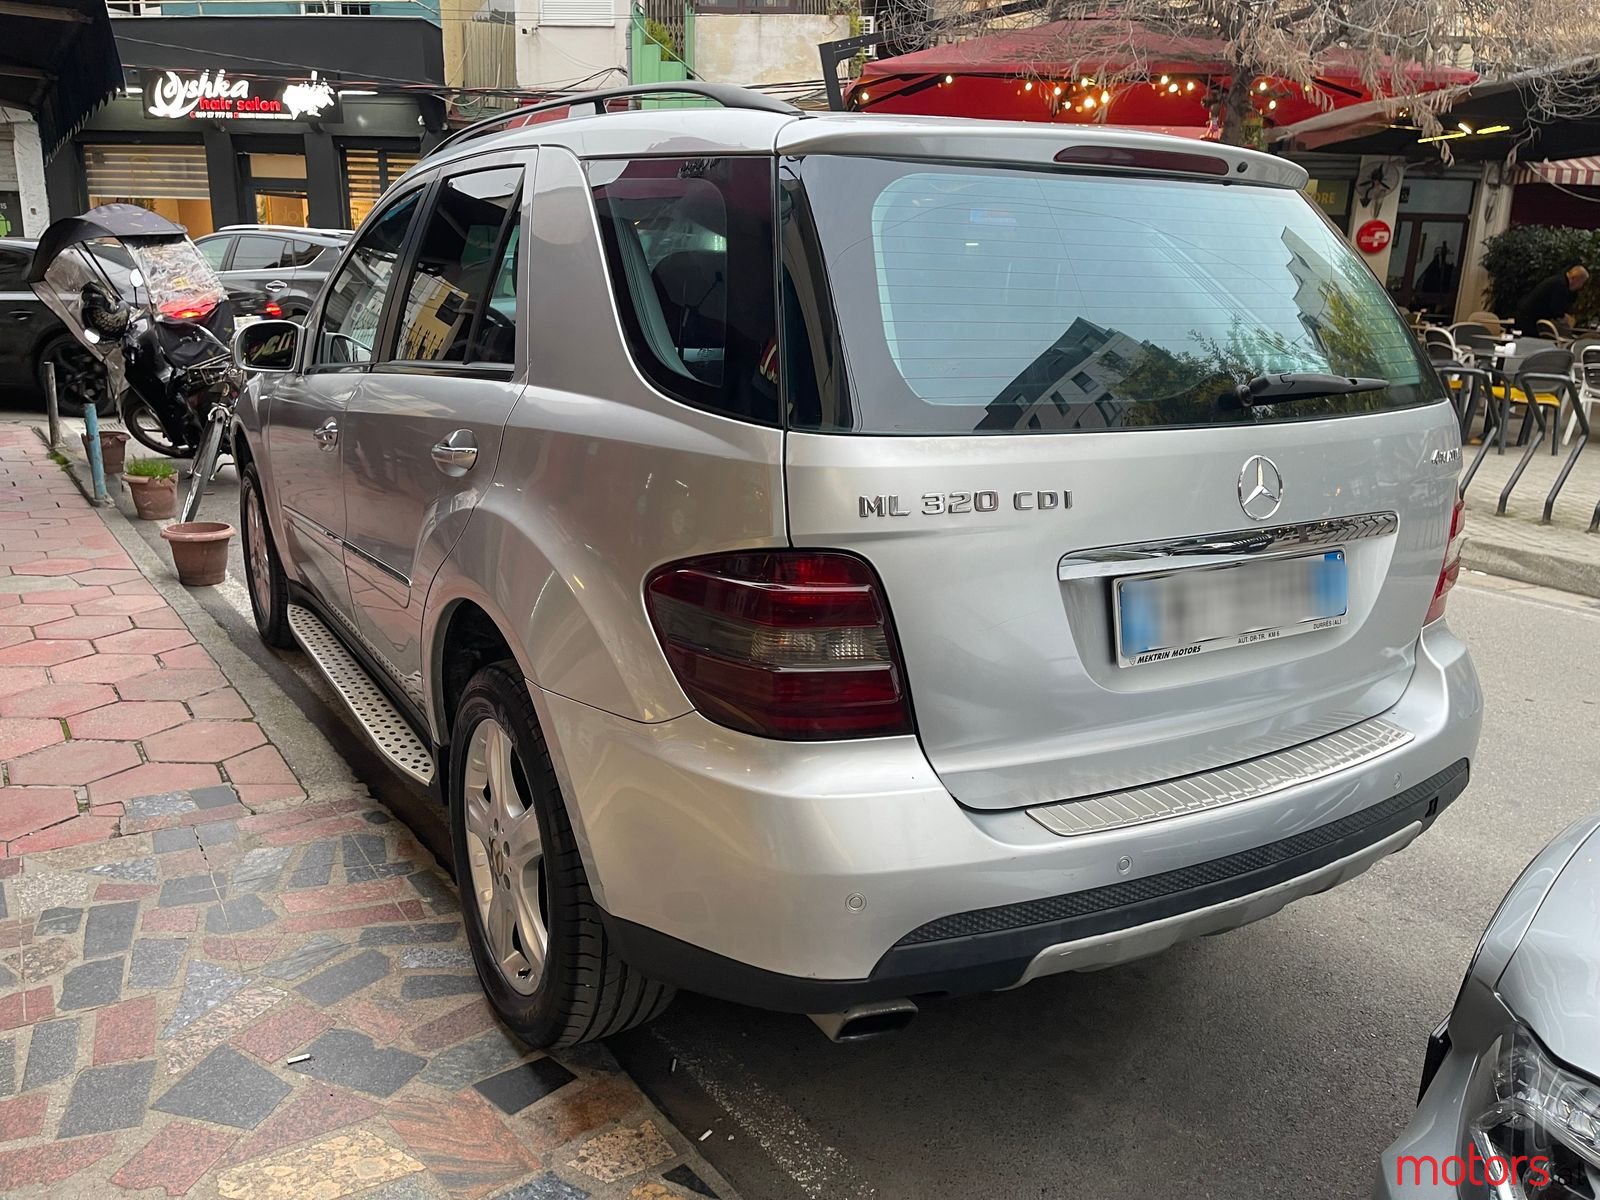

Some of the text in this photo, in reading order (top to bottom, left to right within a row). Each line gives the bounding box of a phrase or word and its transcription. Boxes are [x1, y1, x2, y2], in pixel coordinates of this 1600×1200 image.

[199, 96, 281, 112] hair salon
[858, 489, 1073, 518] ML 320 CDI
[1136, 645, 1201, 665] MEKTRIN MOTORS
